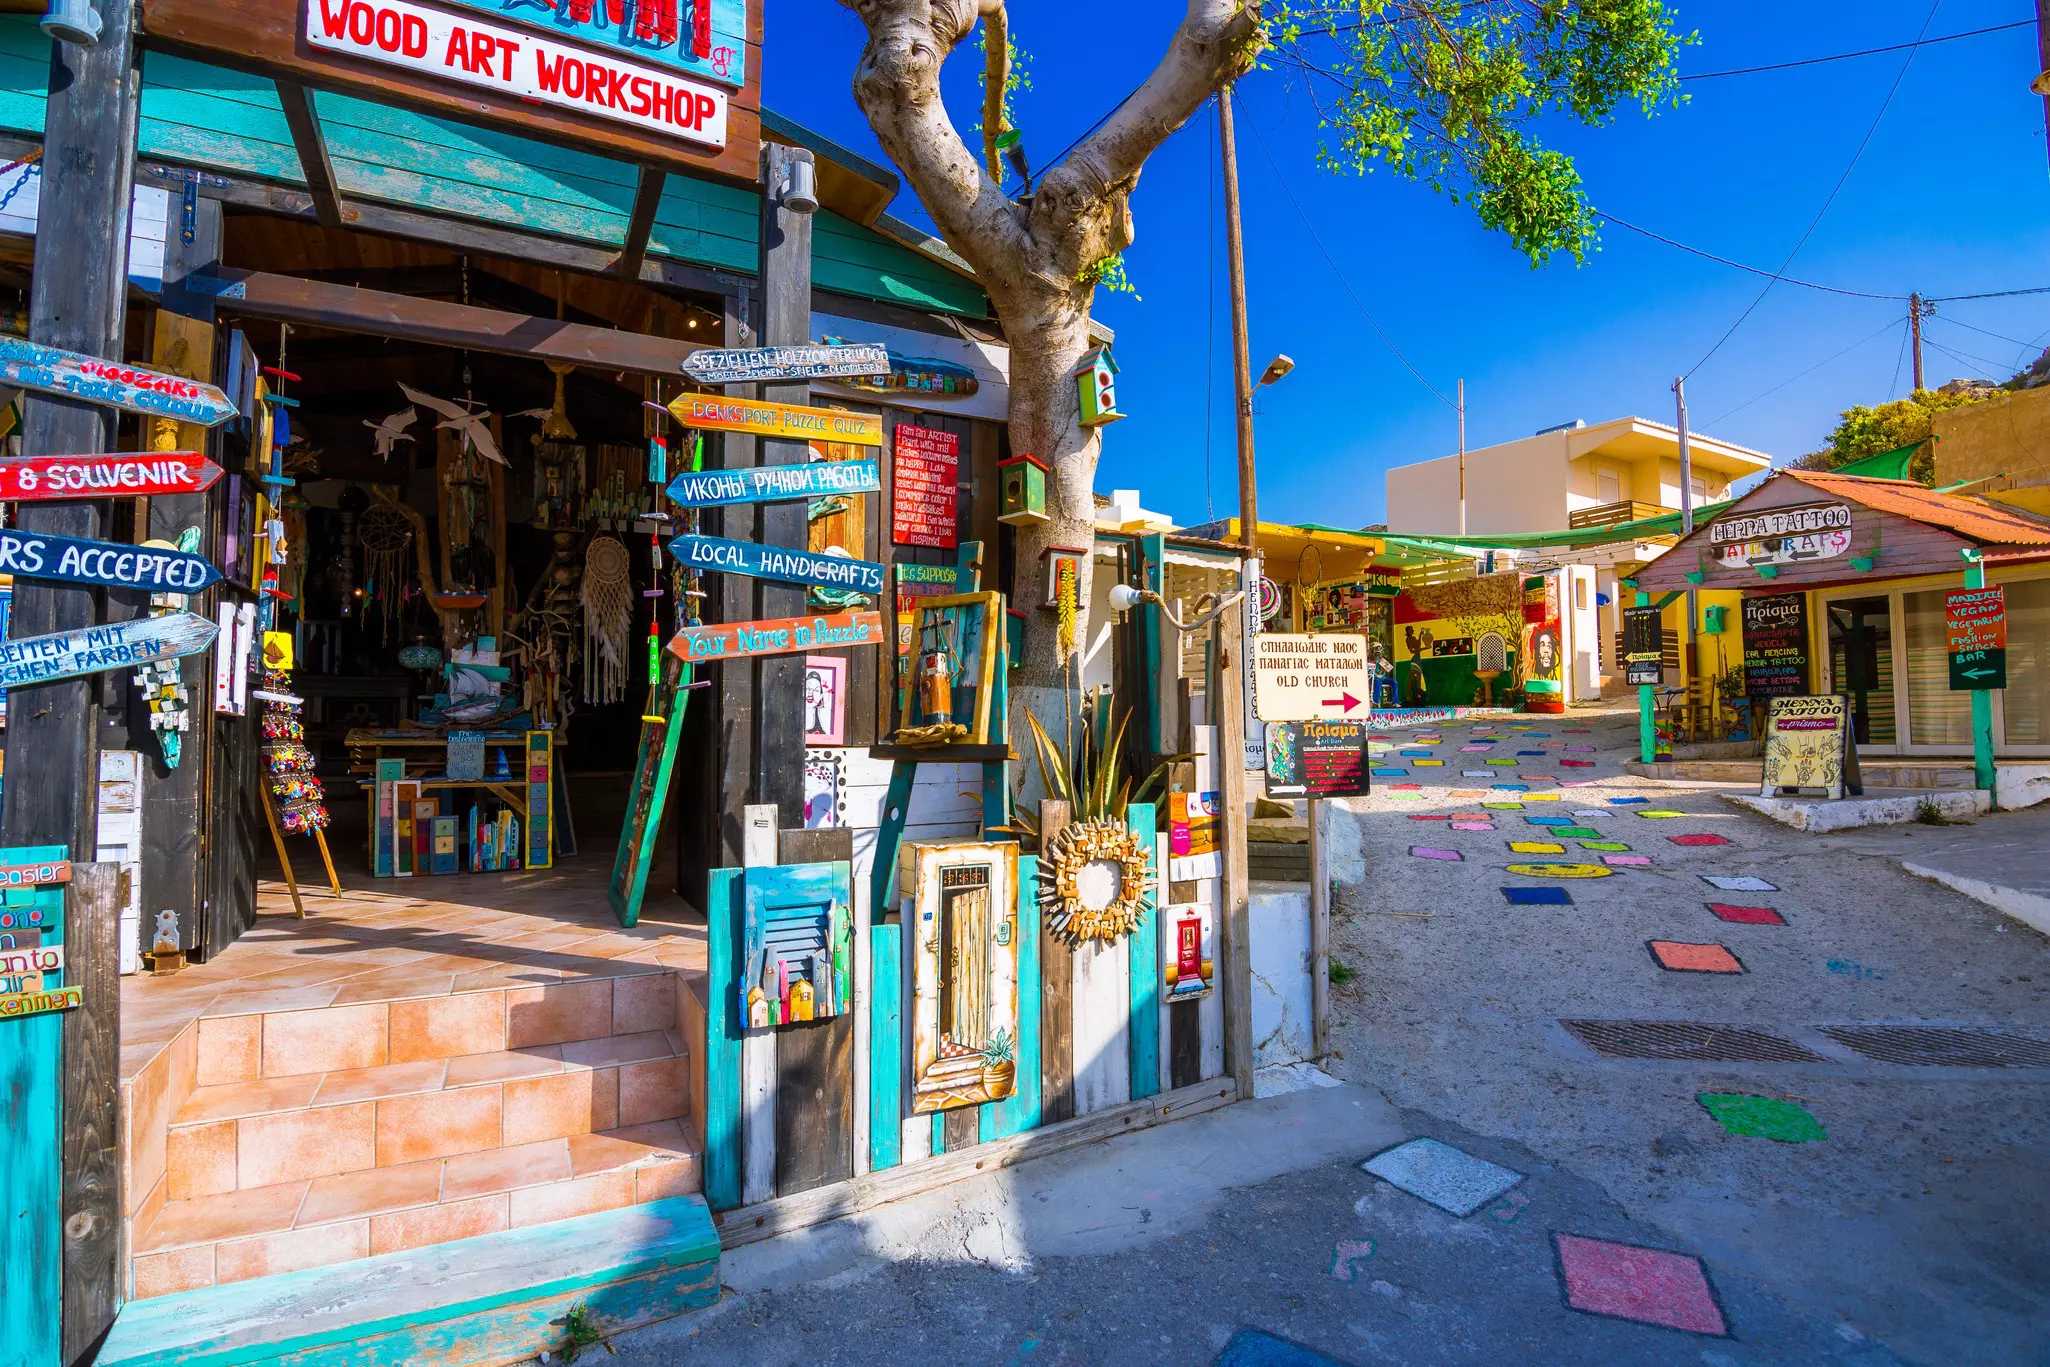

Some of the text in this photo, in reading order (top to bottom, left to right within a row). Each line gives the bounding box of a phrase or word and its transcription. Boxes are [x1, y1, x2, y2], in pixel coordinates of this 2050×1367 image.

[320, 0, 427, 59] WOOD
[445, 27, 519, 82] ART
[535, 49, 716, 132] WORKSHOP
[18, 366, 54, 386] NO
[63, 375, 127, 402] TOXIC
[135, 391, 217, 424] COLOUR
[693, 402, 866, 434] DENKSPORT PUZZLE QUIZ
[19, 468, 38, 490] &
[47, 461, 195, 490] SOUVENIR
[684, 477, 747, 501] ИКОНЫ
[754, 464, 813, 494] РУЧНОЙ
[817, 465, 873, 489] РАБОТЫ
[1714, 509, 1849, 540] HENNA TATTOO
[0, 536, 207, 587] RS ACCEPTED
[691, 541, 880, 588] LOCAL HANDICRAFTS
[1953, 604, 1997, 616] VEGAN
[0, 627, 125, 664] BEITEN MIT
[686, 633, 726, 656] Your
[738, 626, 789, 651] Name
[794, 622, 811, 645] in
[814, 616, 869, 644] Puzzle
[1959, 642, 1998, 653] SNACK
[74, 639, 160, 669] FARBEN
[1770, 656, 1805, 666] TATTOO
[1956, 651, 1986, 664] BAR
[1277, 676, 1348, 687] OLD CHURCH
[1770, 706, 1842, 717] TATTOO
[1777, 698, 1835, 708] HENNA
[0, 865, 64, 886] easier
[31, 950, 58, 970] to
